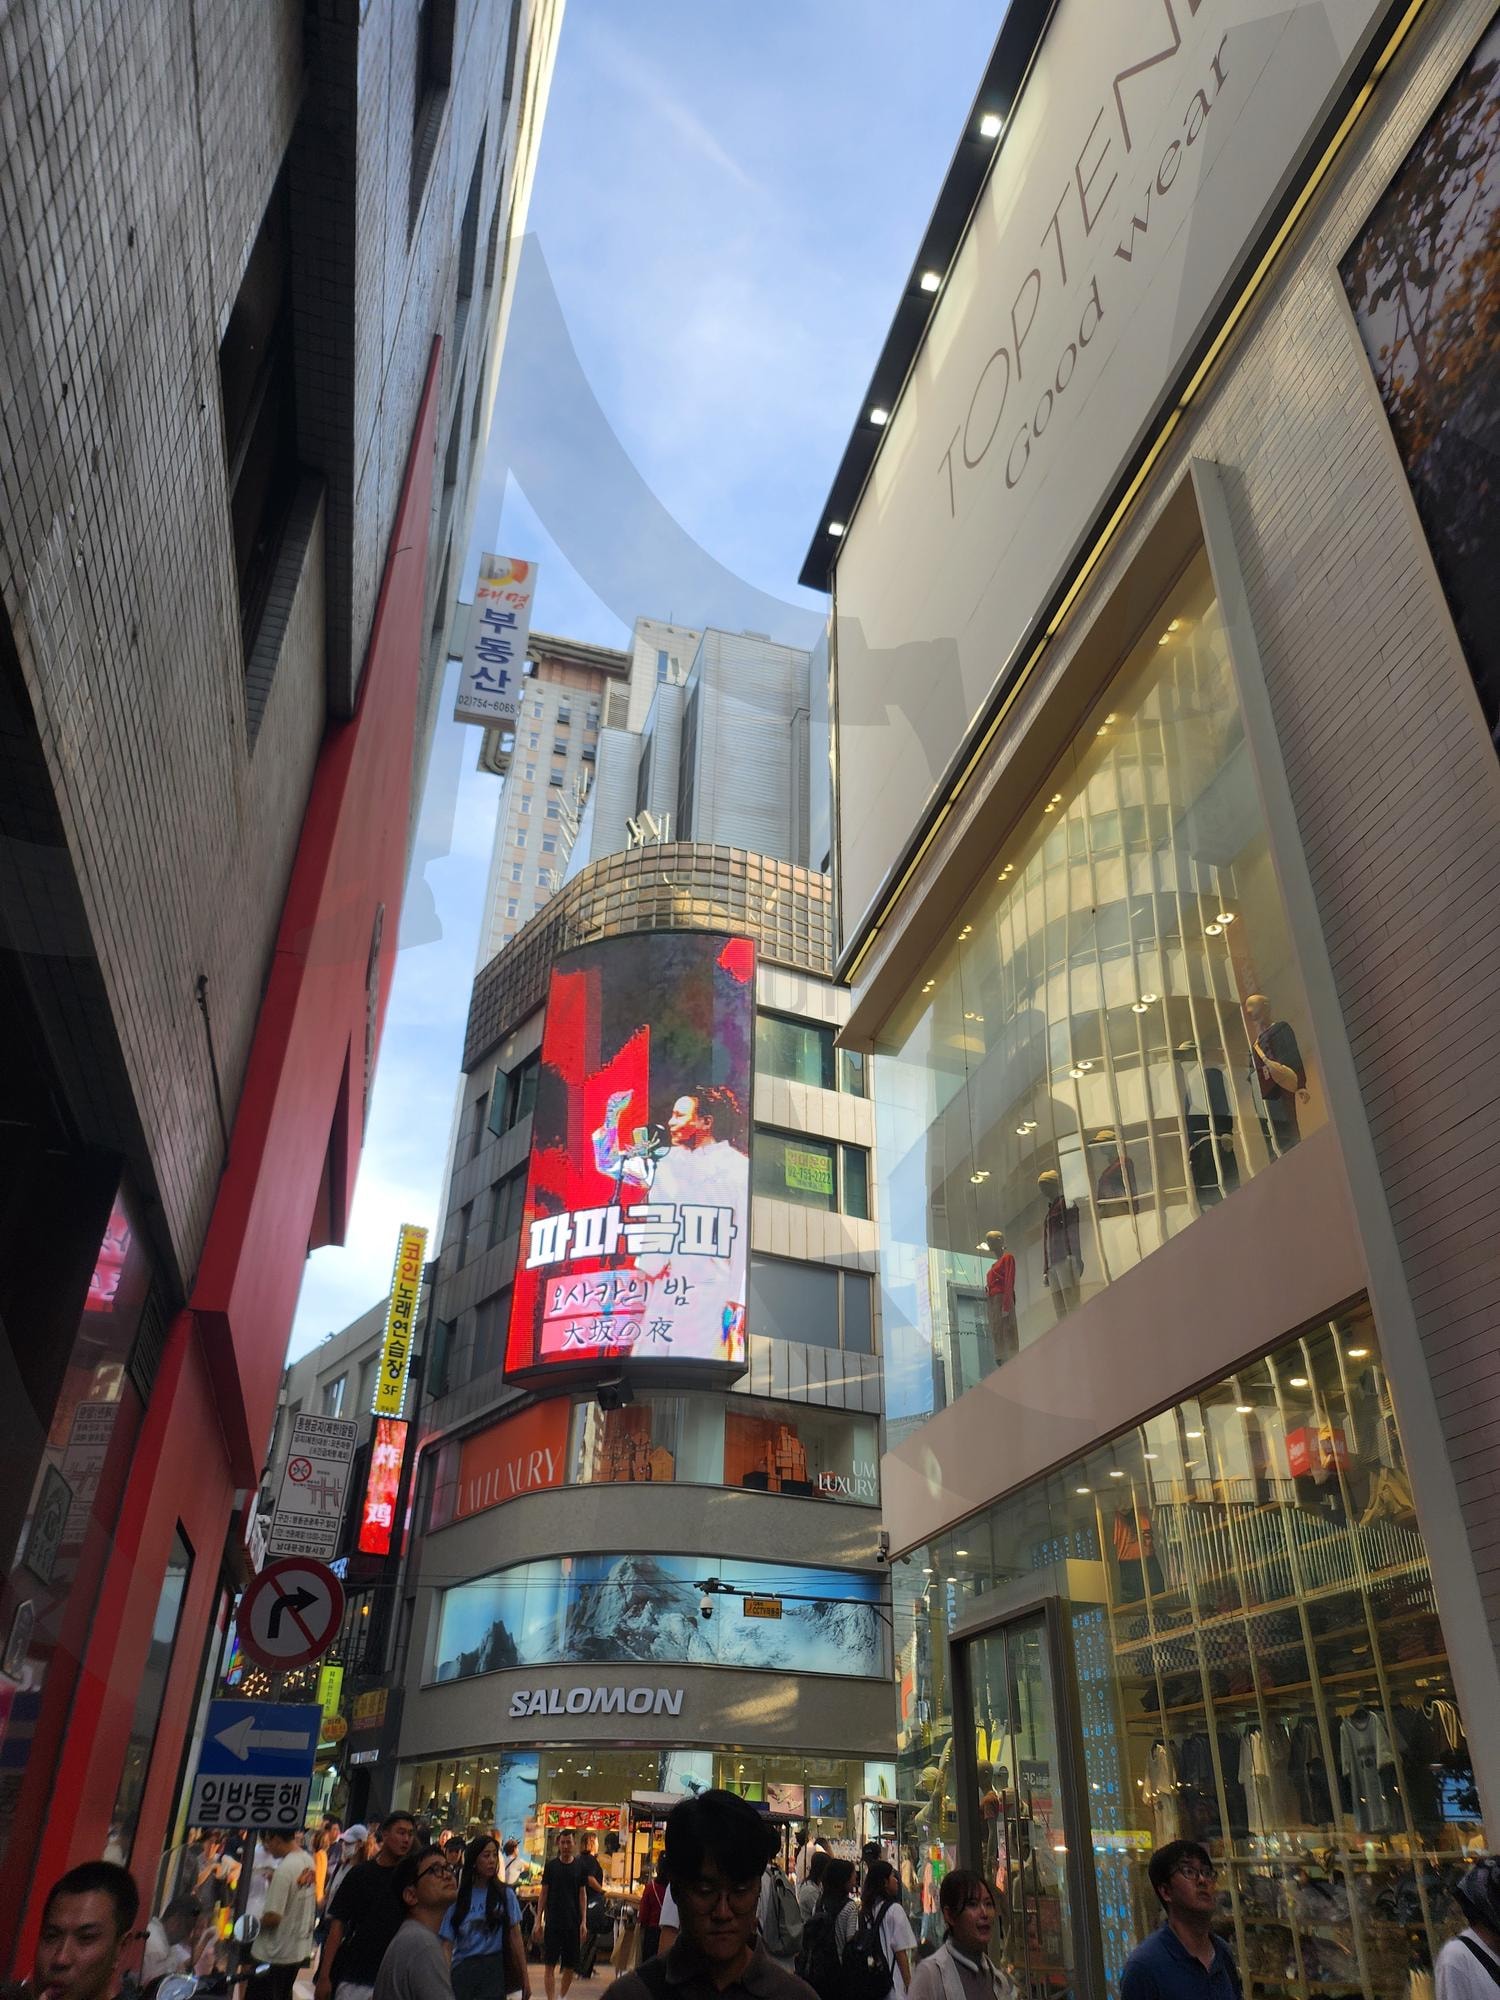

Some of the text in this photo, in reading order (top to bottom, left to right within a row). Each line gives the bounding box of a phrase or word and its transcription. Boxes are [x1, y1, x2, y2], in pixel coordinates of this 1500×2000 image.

[1005, 33, 1229, 490] Good wear
[470, 608, 518, 695] 부동산
[458, 695, 516, 714] 02)754-6065
[525, 1202, 738, 1270] 파파금파
[549, 1275, 695, 1314] 오사카의 밤
[562, 1316, 674, 1349] 大坂の夜
[382, 1383, 399, 1397] 3F
[818, 1473, 877, 1497] LUXURY
[852, 1460, 876, 1479] UM
[508, 1686, 685, 1718] SALOMON
[199, 1781, 302, 1824] 일방통행
